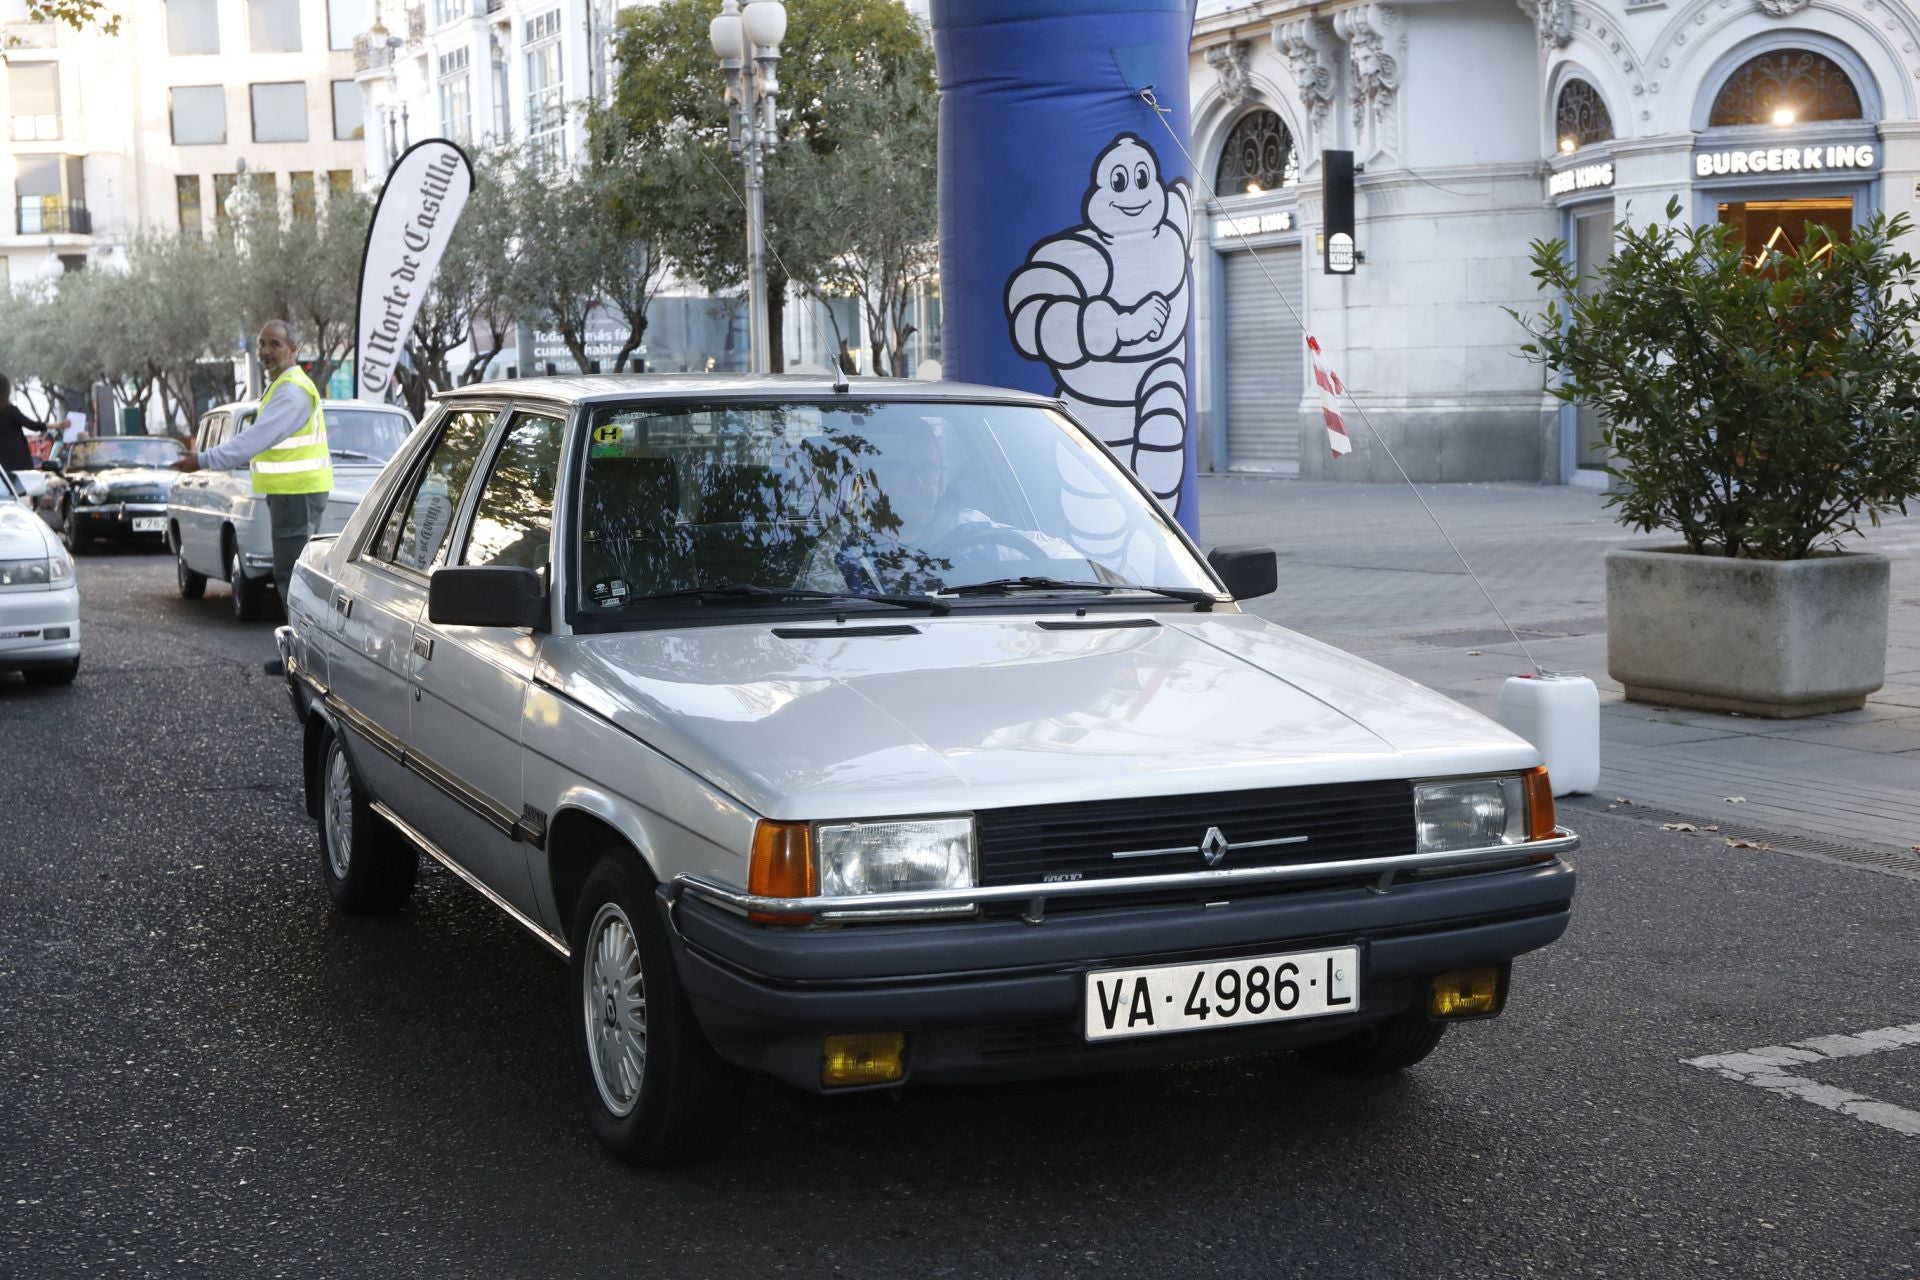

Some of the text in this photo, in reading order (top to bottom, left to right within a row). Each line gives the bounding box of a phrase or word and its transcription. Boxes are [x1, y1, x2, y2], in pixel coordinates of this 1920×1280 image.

[1696, 147, 1801, 176] BURGER
[1576, 163, 1613, 188] KING
[1261, 213, 1290, 232] KING
[1329, 252, 1354, 264] KING
[362, 152, 461, 393] El Norte de Castilla
